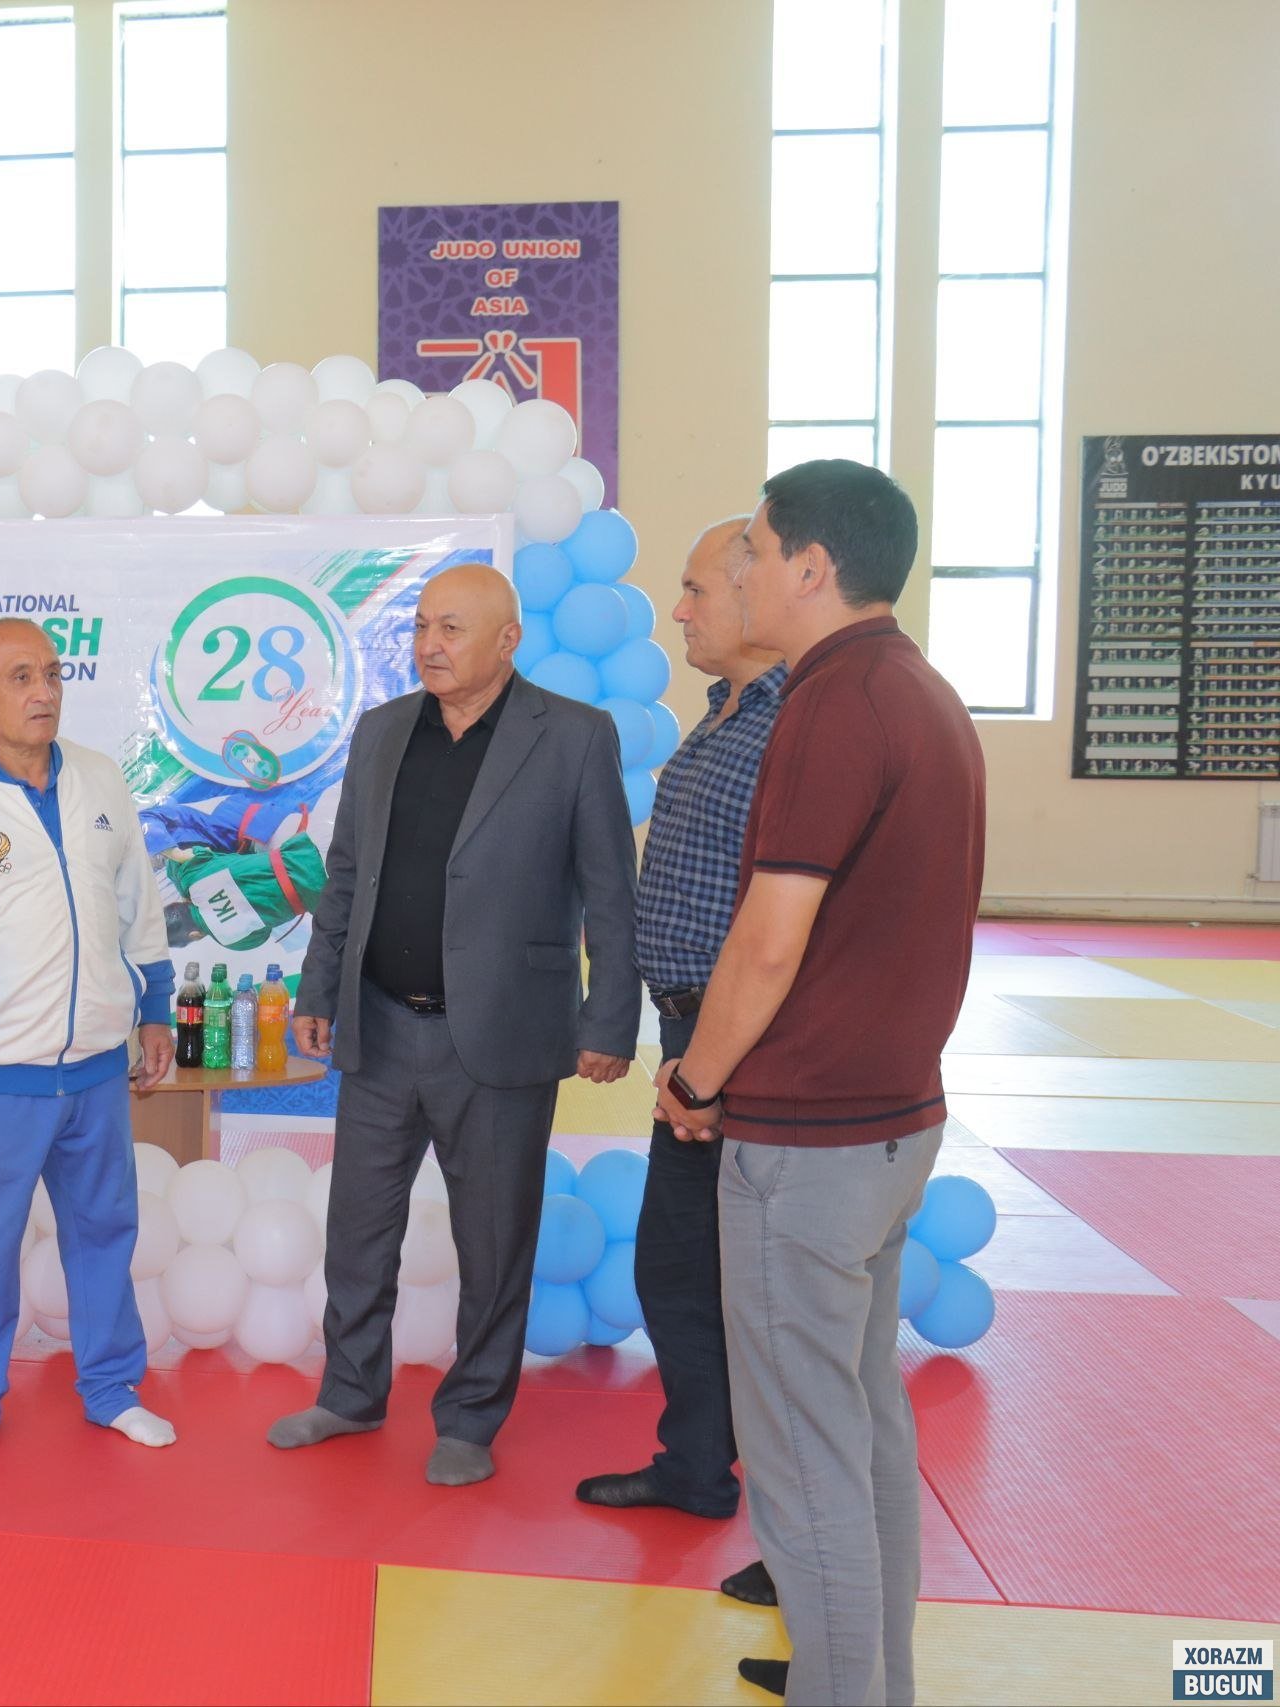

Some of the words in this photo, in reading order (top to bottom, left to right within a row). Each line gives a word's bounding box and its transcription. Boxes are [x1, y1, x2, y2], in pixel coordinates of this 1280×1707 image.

[431, 240, 495, 259] JUDO
[503, 239, 580, 258] UNION
[485, 269, 518, 288] OF
[471, 297, 529, 316] ASIA
[197, 625, 306, 702] 28
[208, 888, 238, 924] IKA
